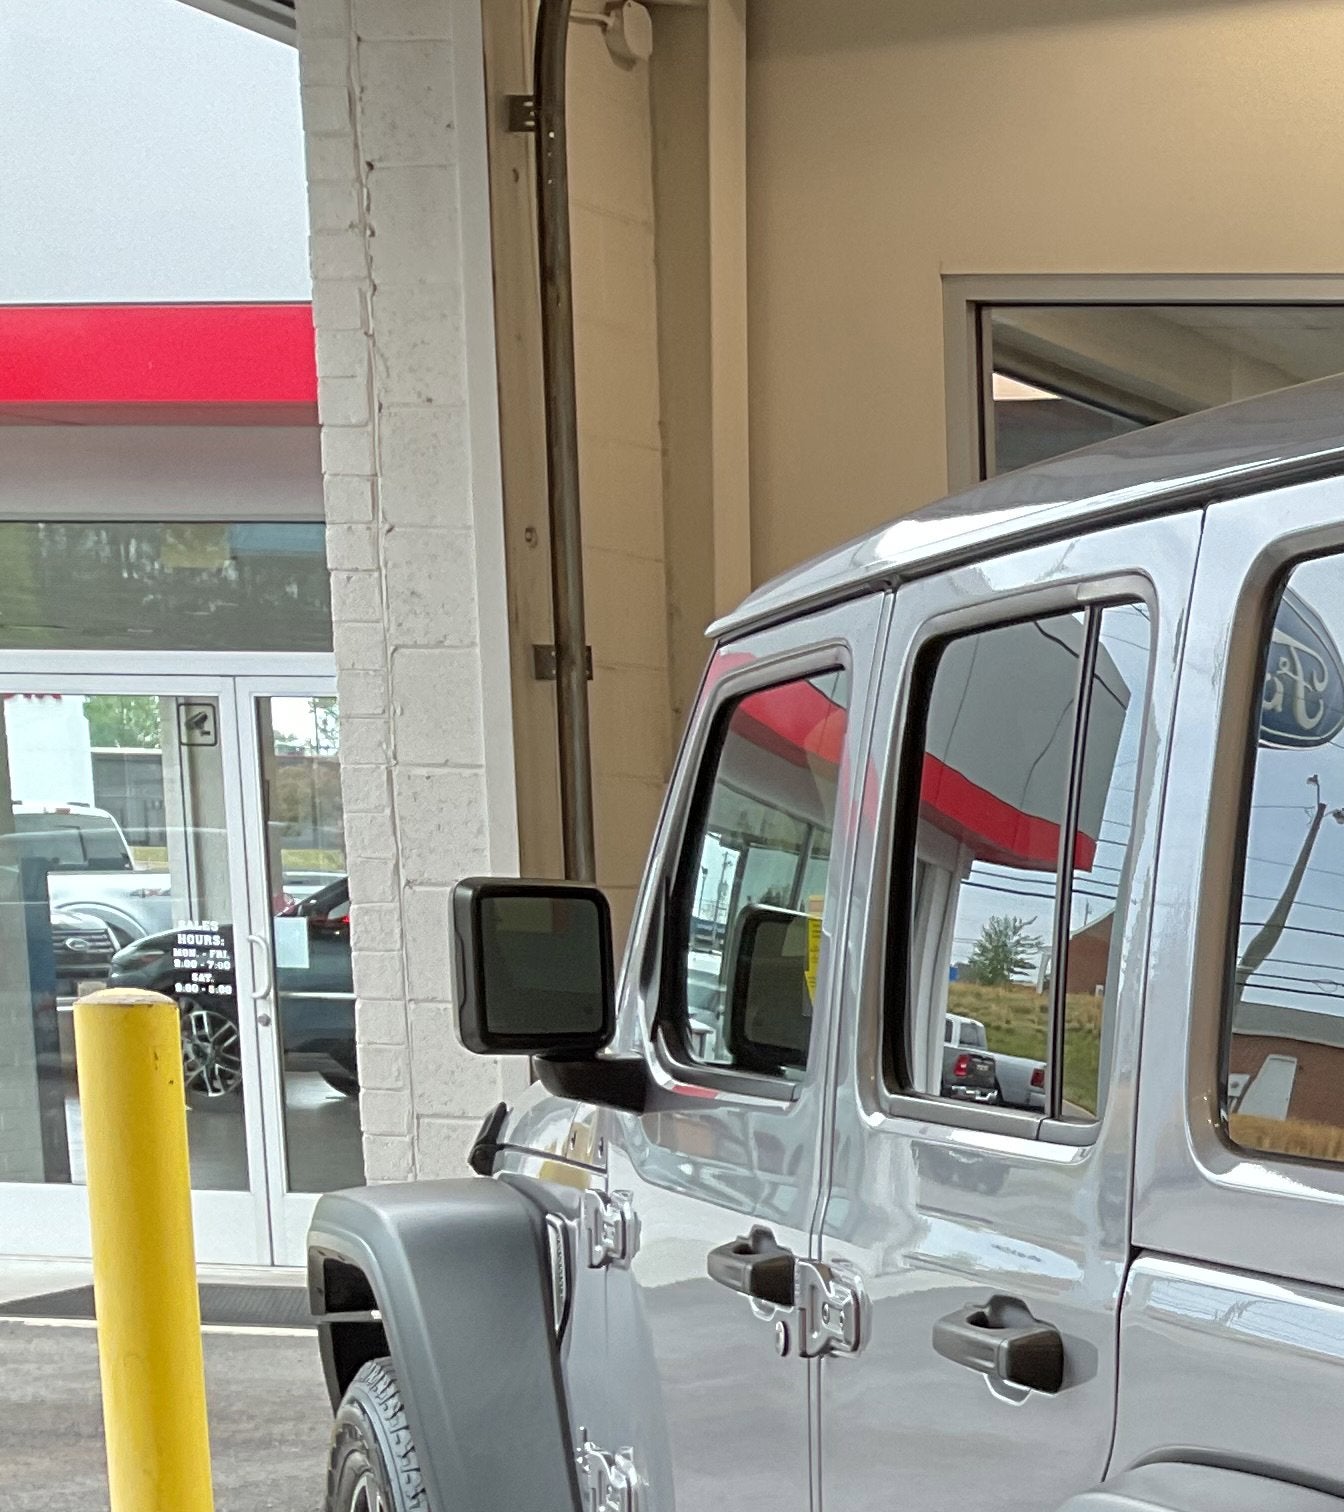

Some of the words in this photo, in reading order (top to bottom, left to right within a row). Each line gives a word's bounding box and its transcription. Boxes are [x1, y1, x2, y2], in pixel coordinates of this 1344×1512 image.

[178, 920, 219, 932] SALES
[177, 933, 225, 946] HOURS:
[173, 947, 200, 958] MON.
